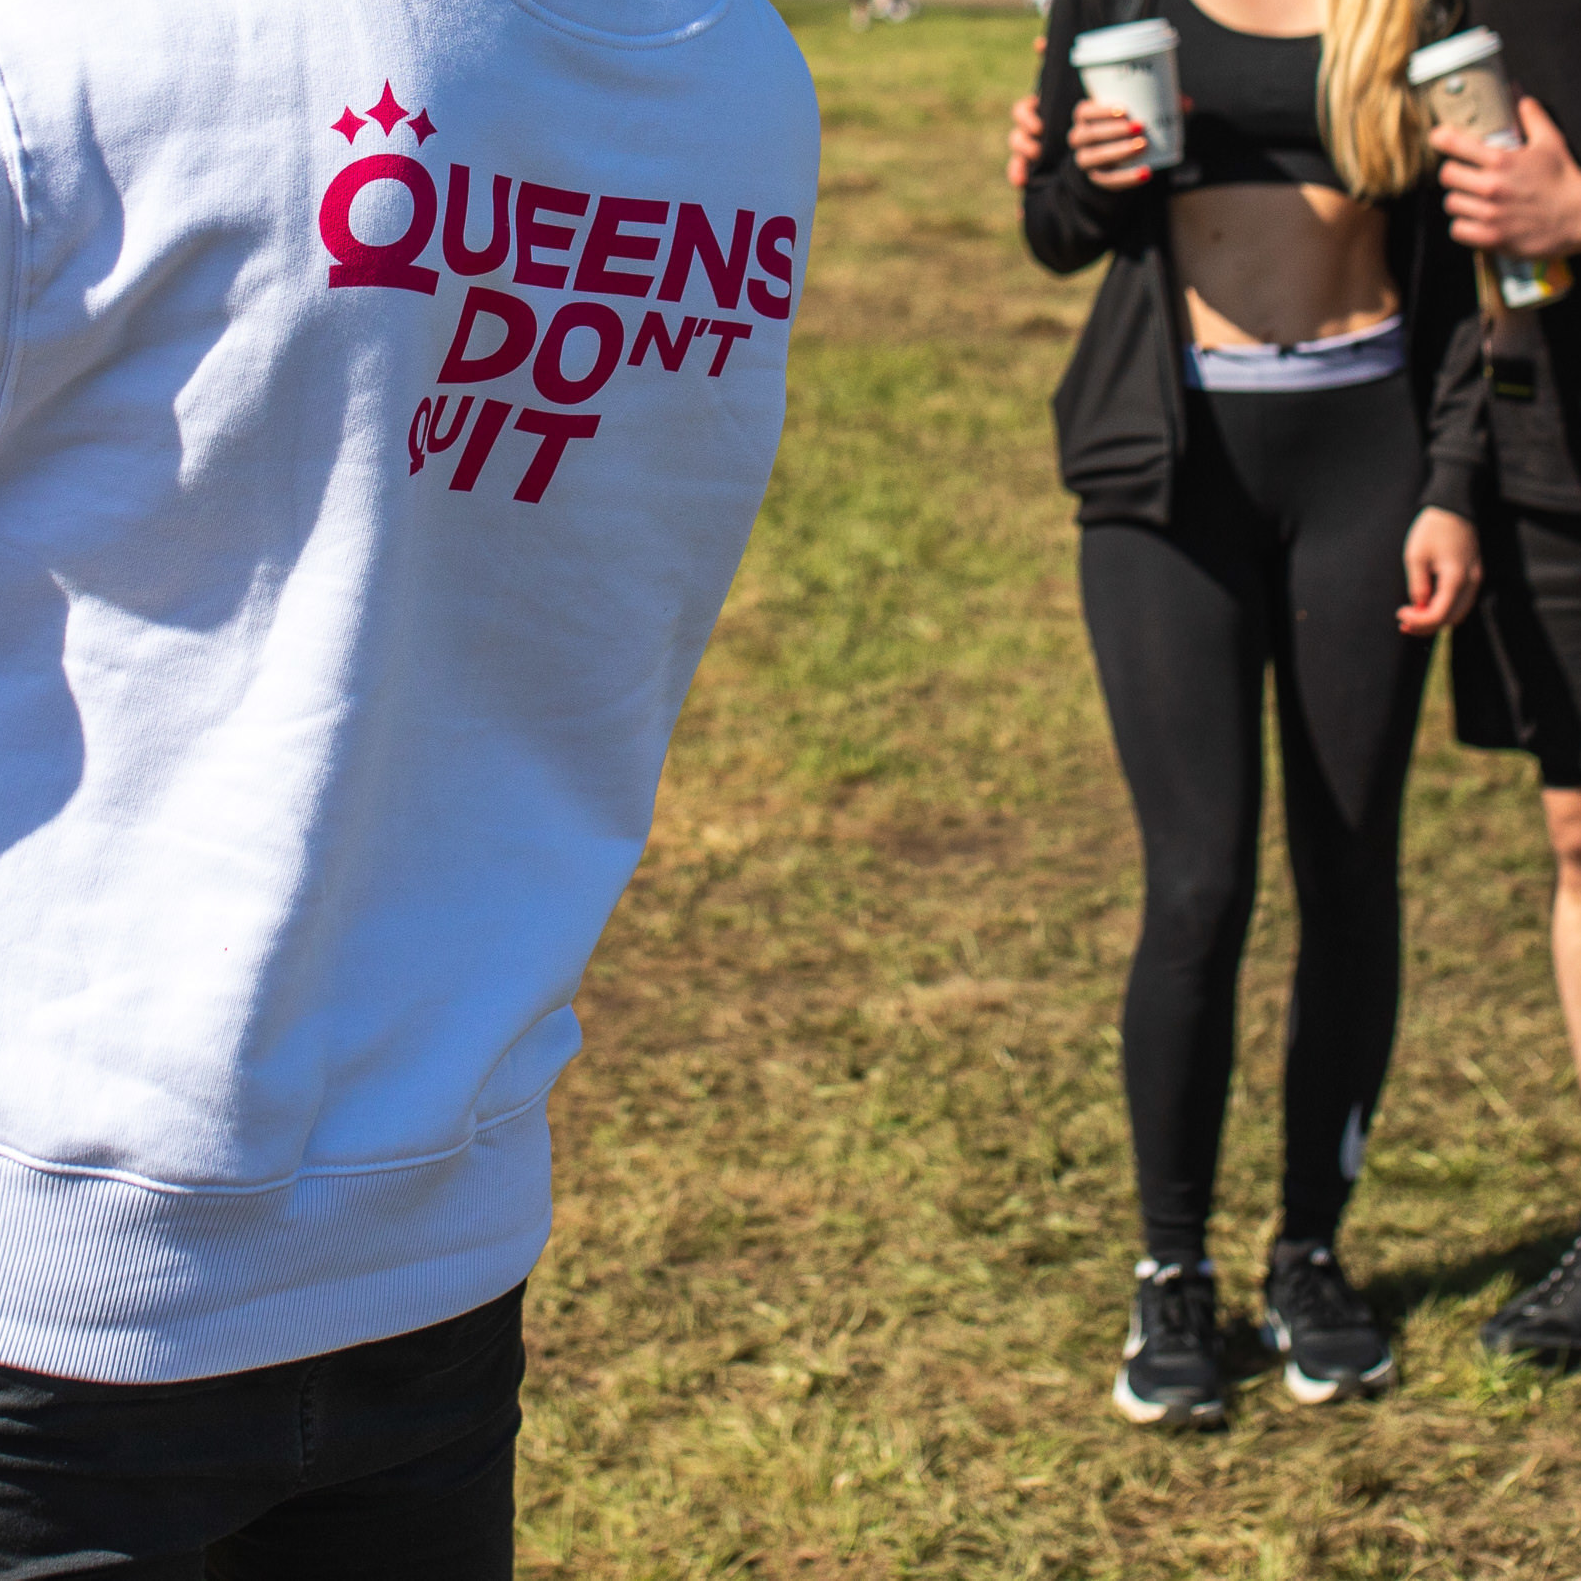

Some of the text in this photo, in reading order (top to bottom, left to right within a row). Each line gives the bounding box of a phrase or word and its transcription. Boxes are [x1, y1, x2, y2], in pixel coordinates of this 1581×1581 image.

[318, 153, 797, 320] QUEENS
[436, 285, 753, 405] DON'T
[408, 395, 602, 504] QUIT
